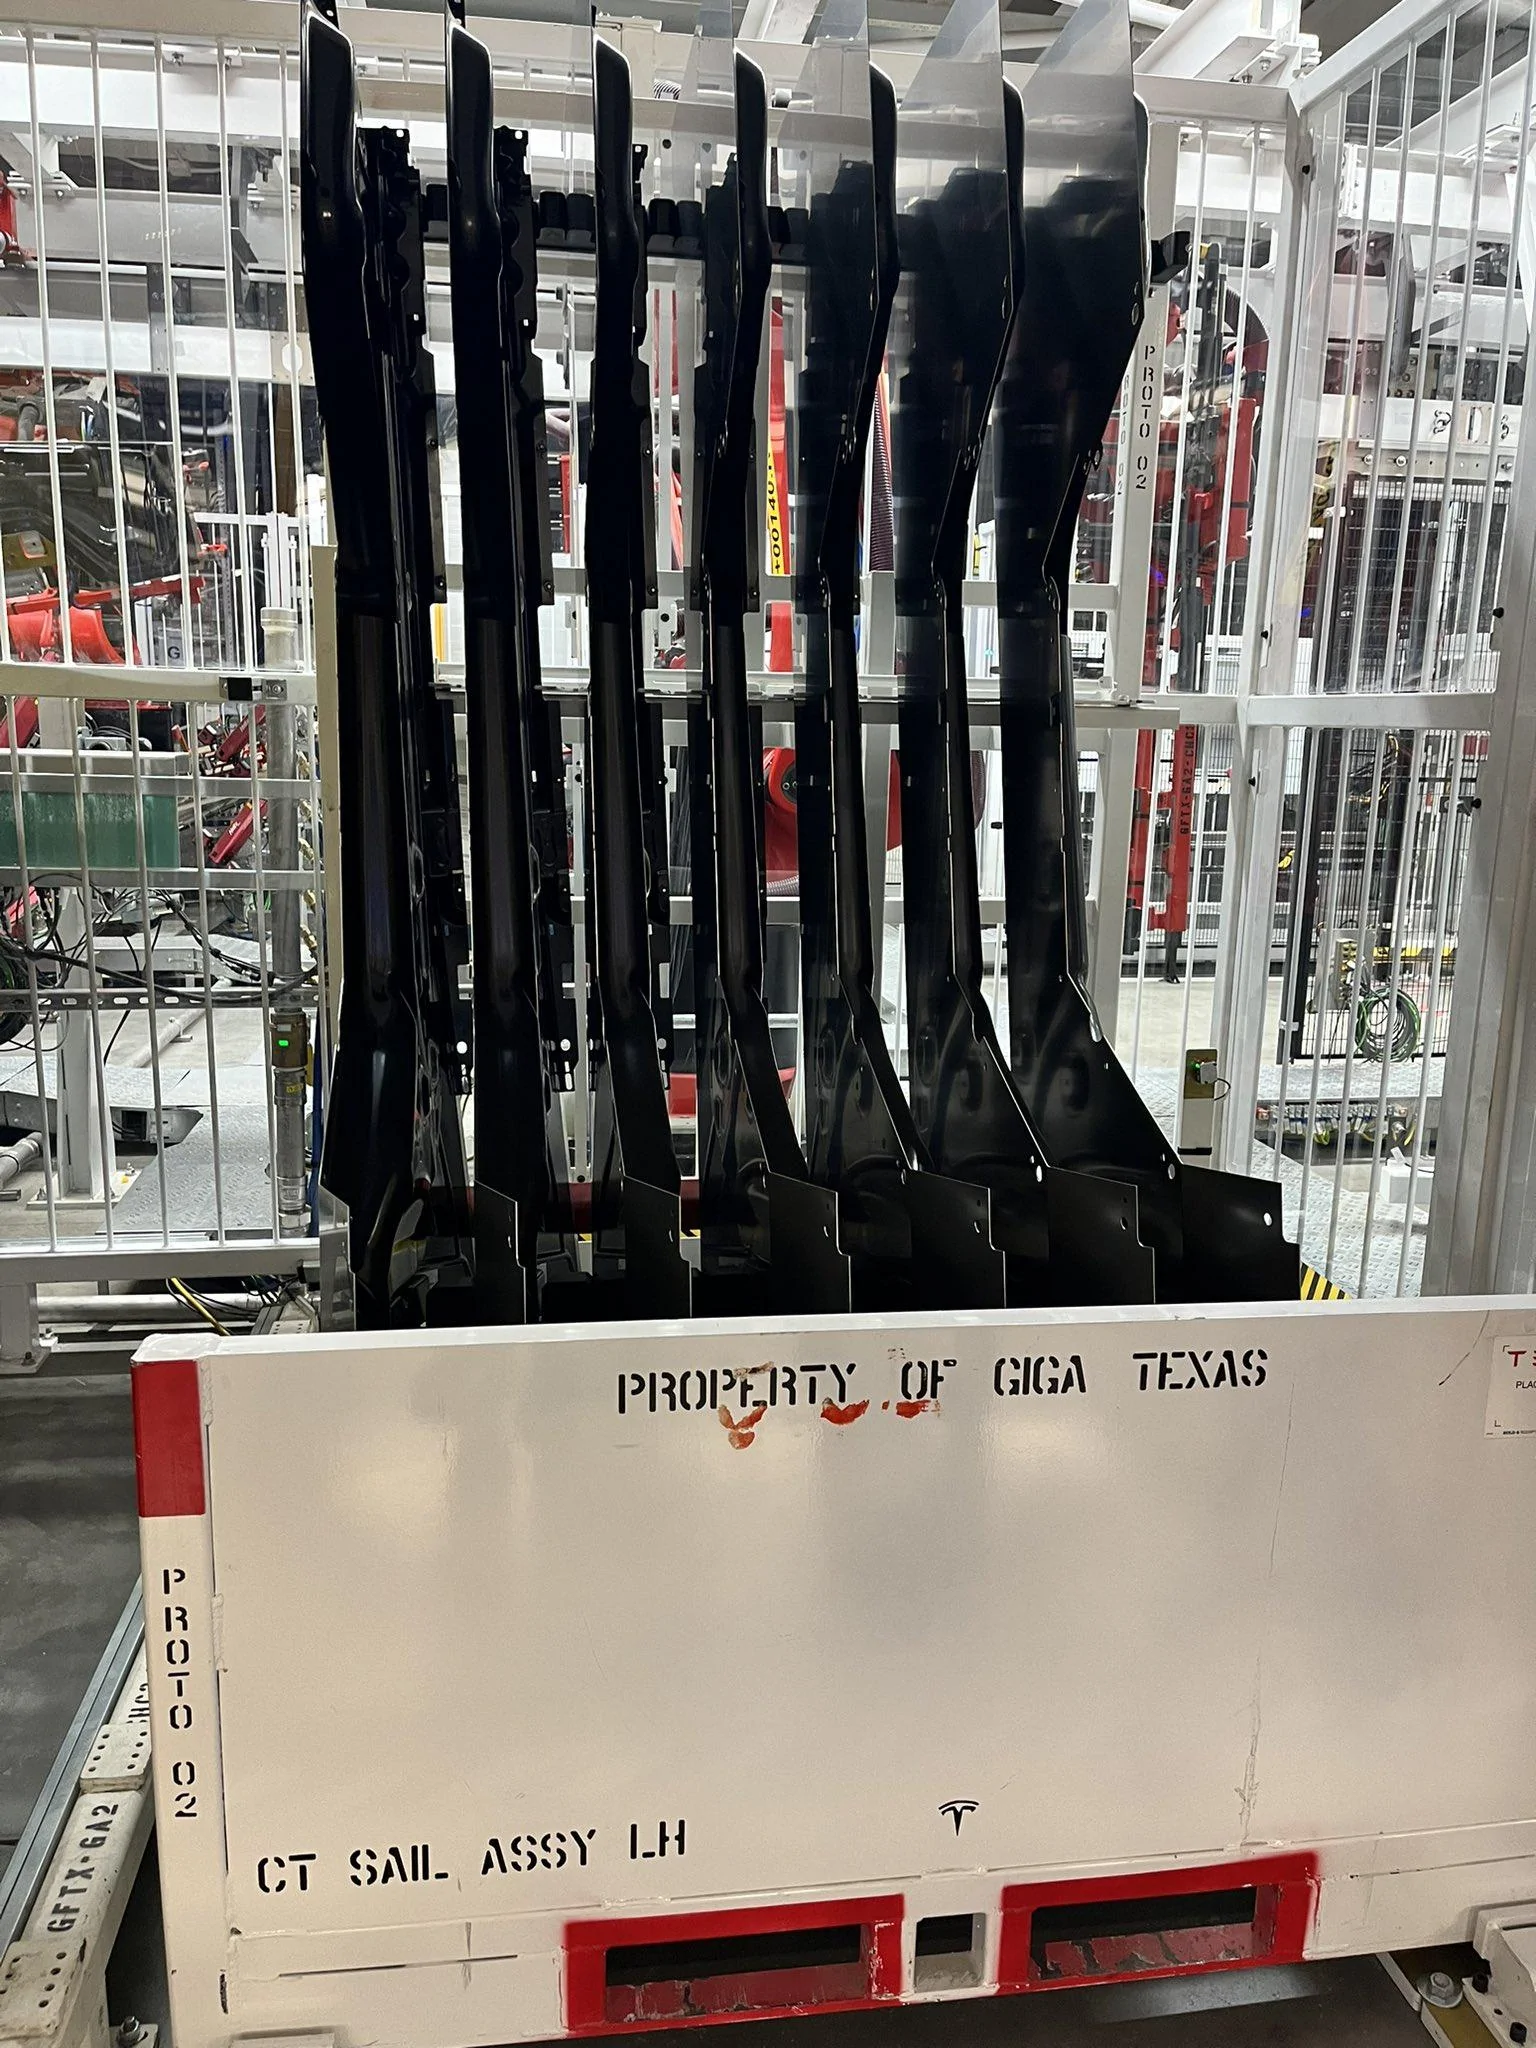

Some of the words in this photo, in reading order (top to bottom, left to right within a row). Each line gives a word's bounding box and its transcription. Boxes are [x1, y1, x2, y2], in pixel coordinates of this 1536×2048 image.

[1139, 345, 1155, 438] PROTO
[1135, 455, 1148, 490] 02
[618, 1363, 856, 1414] PROPERTY
[900, 1359, 957, 1400] OF
[993, 1355, 1087, 1396] GIGA
[1132, 1349, 1268, 1391] TEXAS
[1507, 1350, 1536, 1367] T
[163, 1568, 193, 1729] PROTO
[172, 1761, 198, 1818] 02
[257, 1853, 317, 1893] CT
[349, 1844, 449, 1887] SAIL
[481, 1828, 597, 1876] ASSY
[630, 1819, 686, 1860] LH
